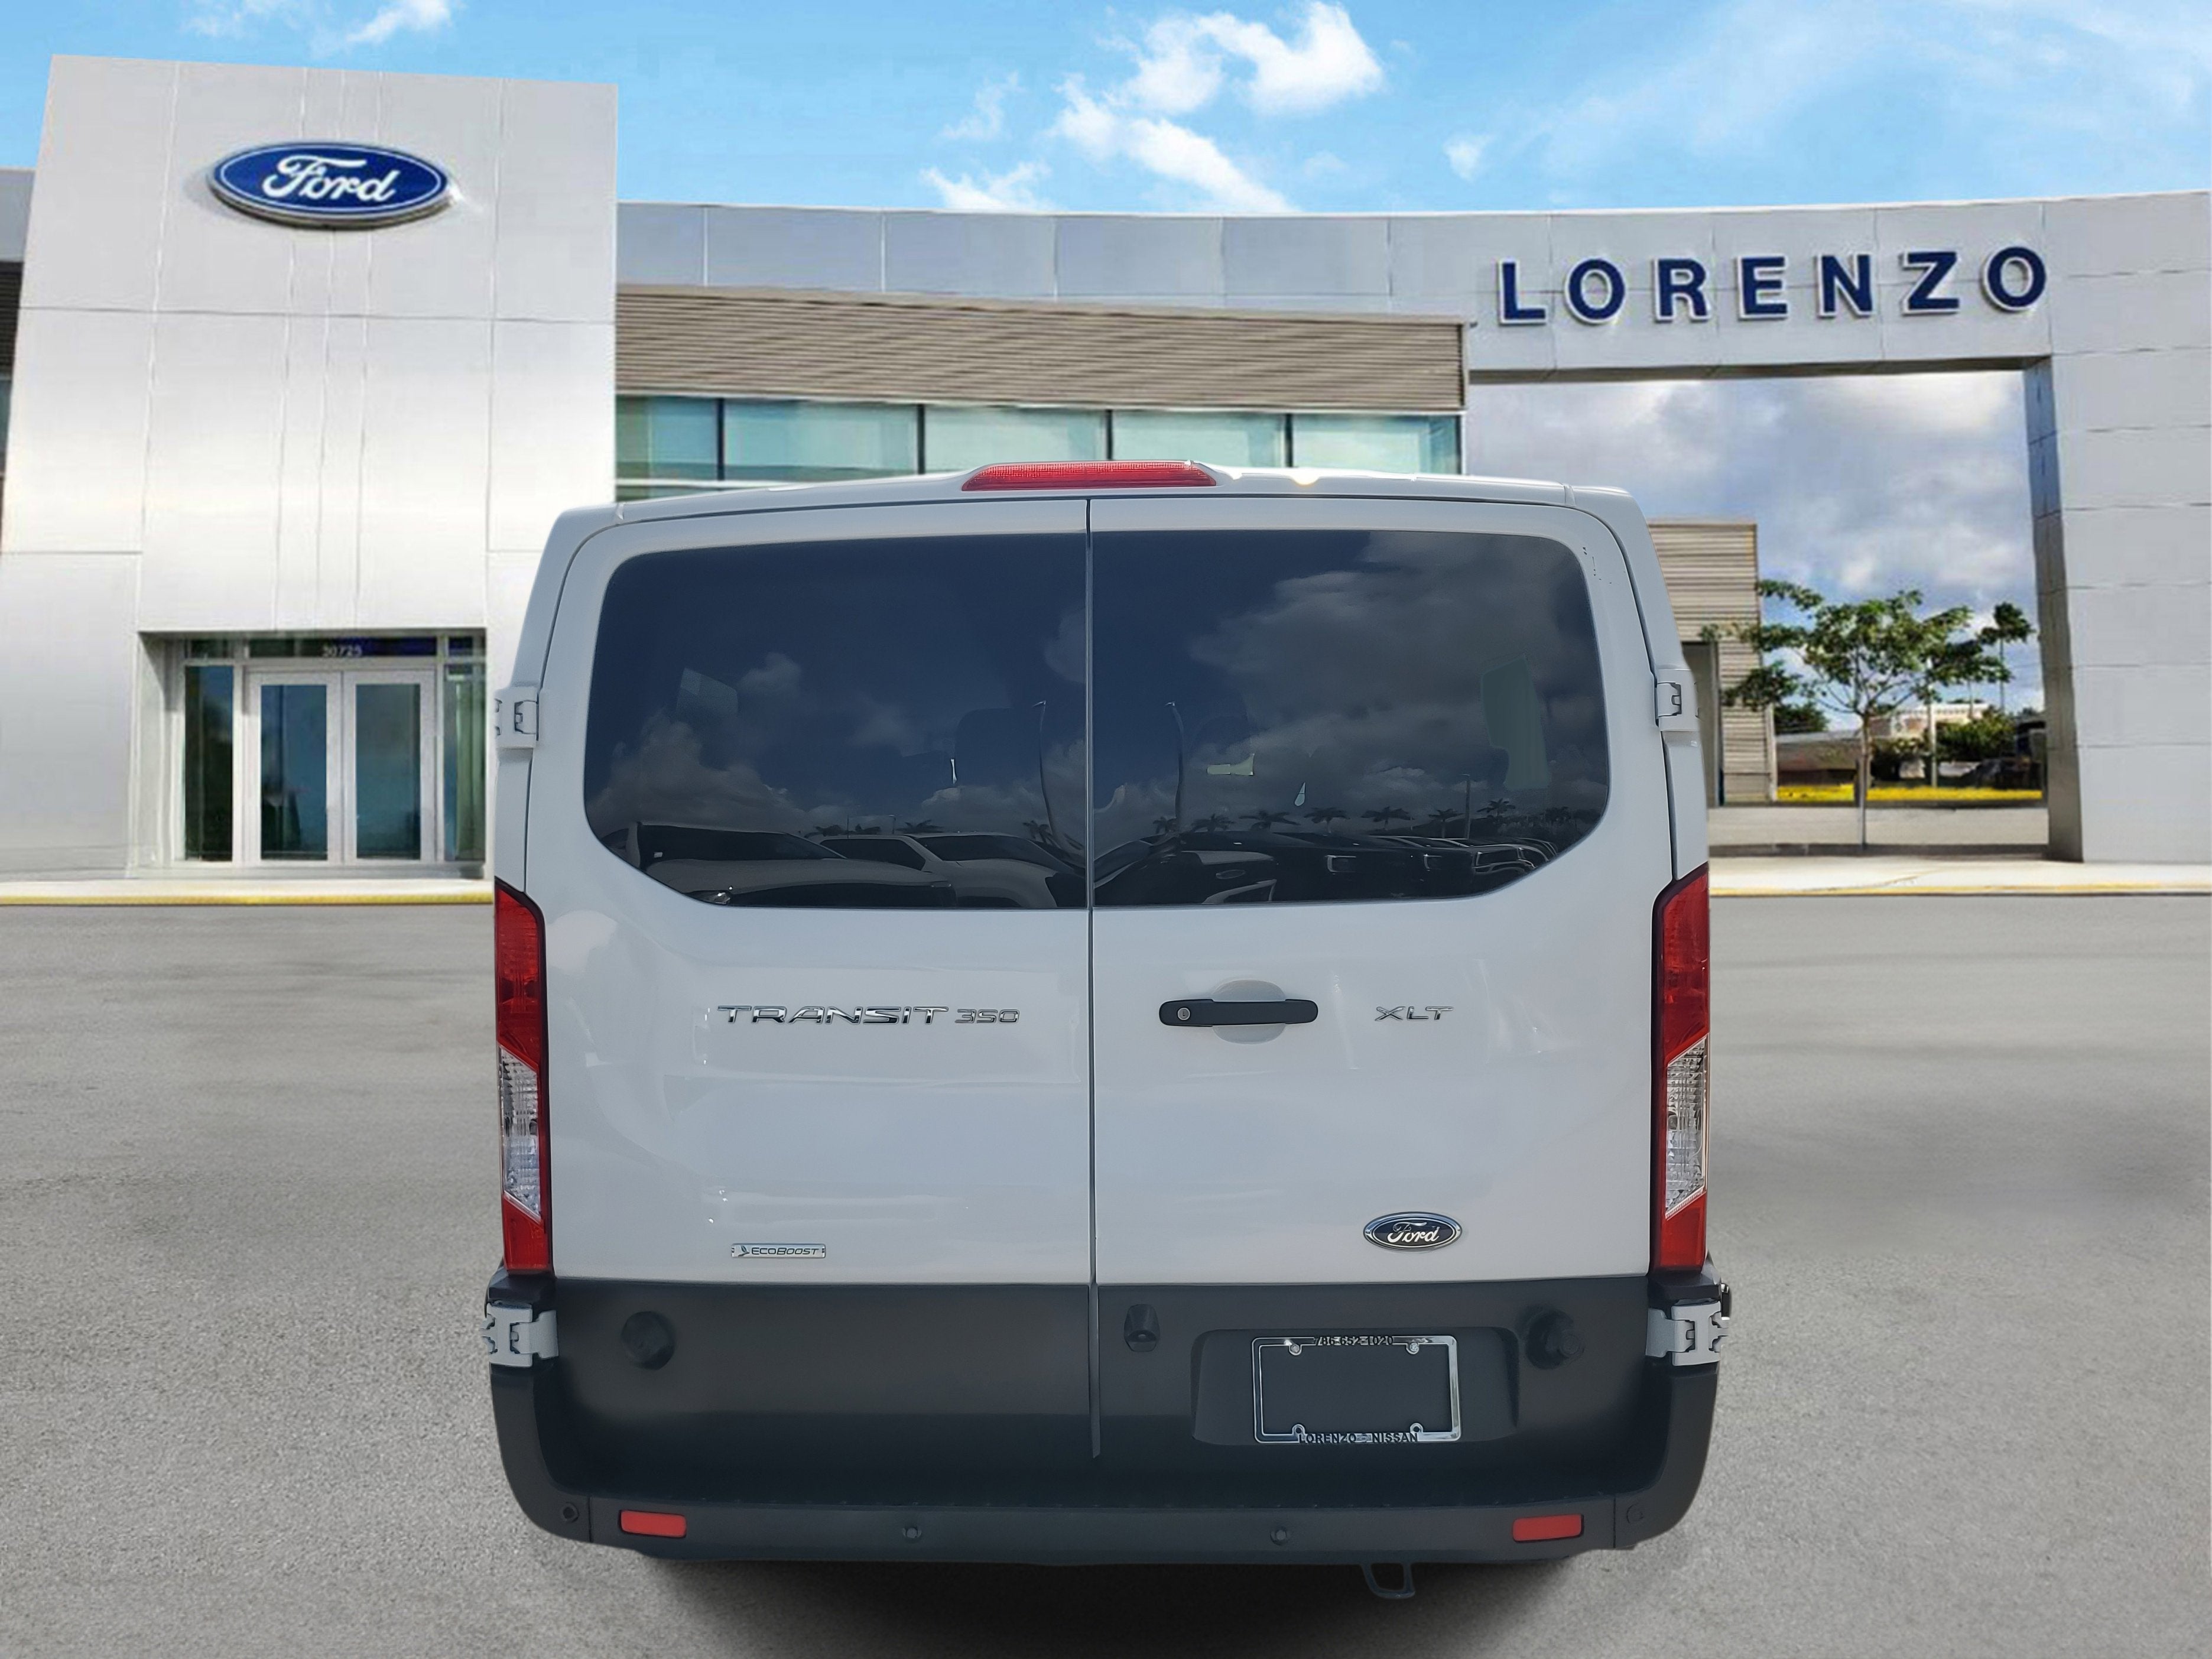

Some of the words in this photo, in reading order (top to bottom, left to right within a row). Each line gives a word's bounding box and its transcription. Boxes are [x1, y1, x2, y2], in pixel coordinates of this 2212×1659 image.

[262, 154, 400, 202] Ford
[1498, 246, 2047, 323] LORENZO
[717, 1005, 949, 1024] TRANSIT
[955, 1009, 1020, 1024] 350
[1375, 1006, 1454, 1021] XLT
[1387, 1222, 1440, 1243] Ford
[1300, 1433, 1357, 1443] LORENZO
[1371, 1432, 1418, 1443] NISSAN
